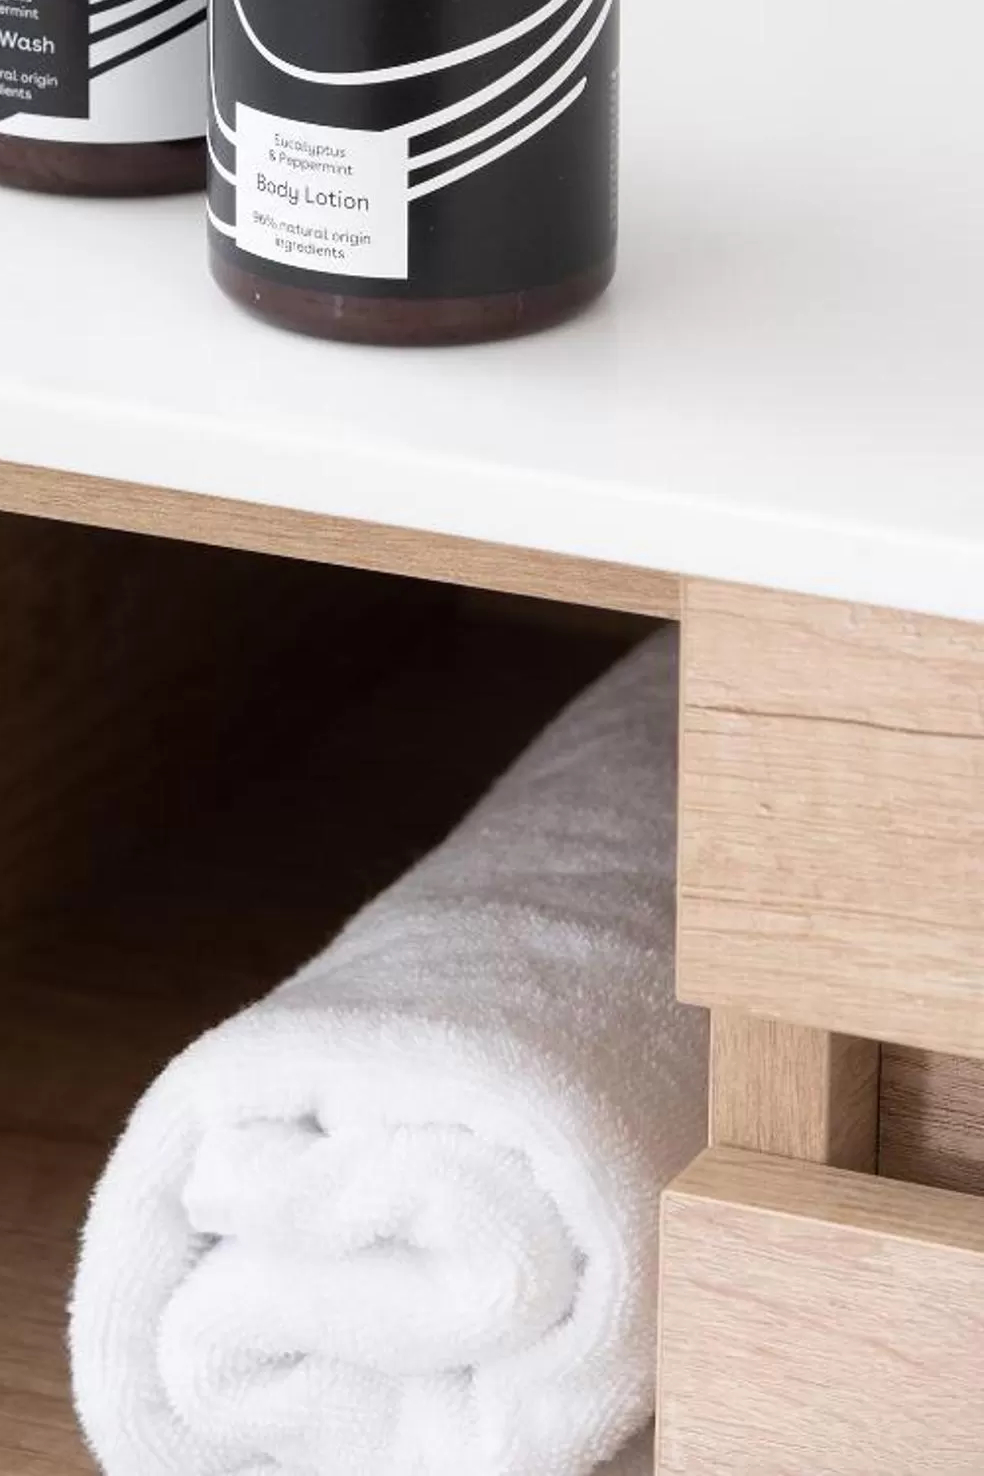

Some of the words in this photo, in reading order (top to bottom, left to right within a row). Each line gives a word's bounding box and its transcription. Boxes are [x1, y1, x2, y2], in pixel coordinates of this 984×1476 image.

[21, 73, 58, 90] origin
[274, 133, 347, 159] Eucalyptus
[279, 152, 353, 176] Peppermint
[256, 172, 299, 206] Body
[305, 185, 370, 212] Lotion
[280, 221, 329, 241] natural
[332, 231, 372, 247] origin
[274, 236, 346, 259] ingredients
